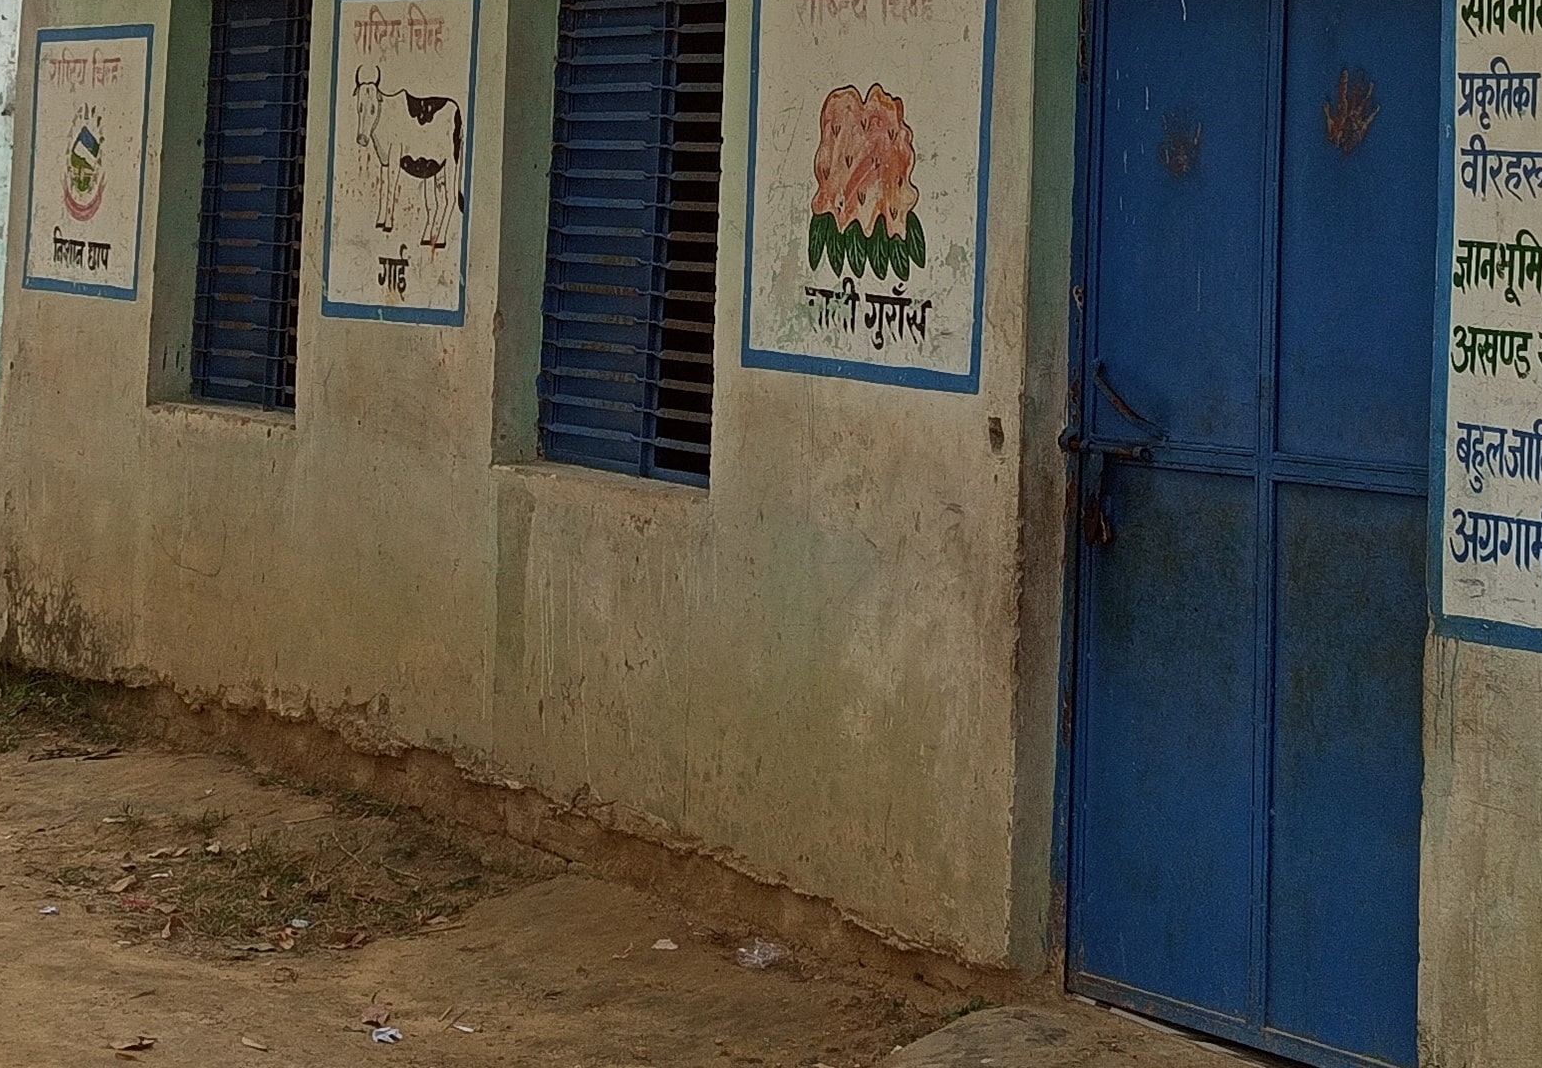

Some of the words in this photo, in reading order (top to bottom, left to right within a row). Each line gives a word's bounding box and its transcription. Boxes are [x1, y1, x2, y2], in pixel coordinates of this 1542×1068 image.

[1457, 55, 1542, 131] प्रकृतिका
[377, 243, 410, 303] गाई
[1450, 324, 1534, 380] अखण्ड
